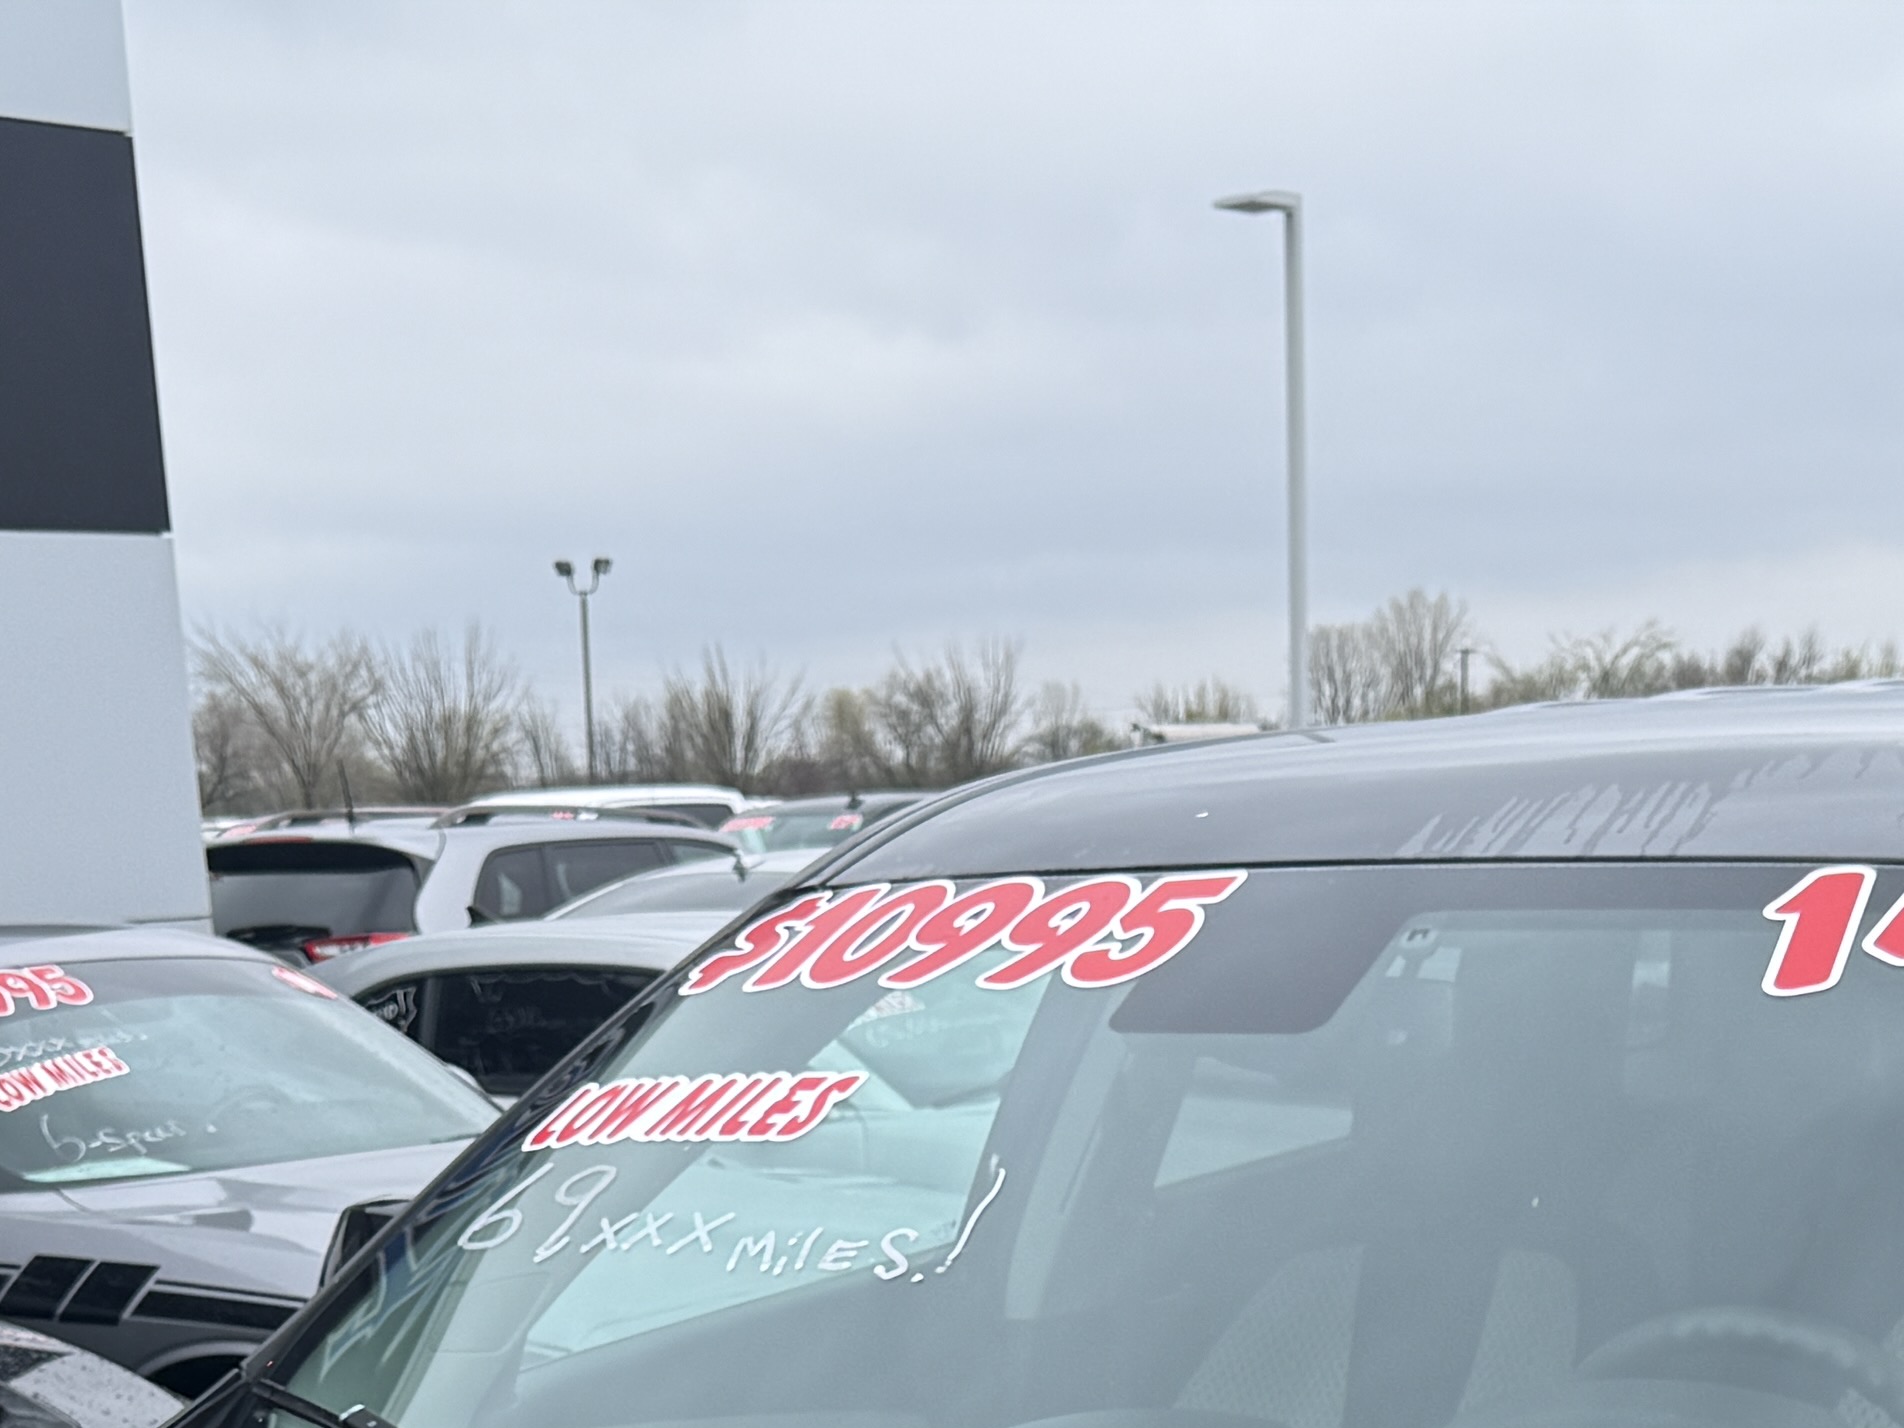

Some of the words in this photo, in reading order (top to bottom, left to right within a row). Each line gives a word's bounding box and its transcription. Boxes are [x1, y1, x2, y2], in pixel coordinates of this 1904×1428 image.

[679, 870, 1248, 995] $10995
[40, 1045, 129, 1092] MILES
[523, 1080, 685, 1150] LOW
[642, 1071, 868, 1143] MILES
